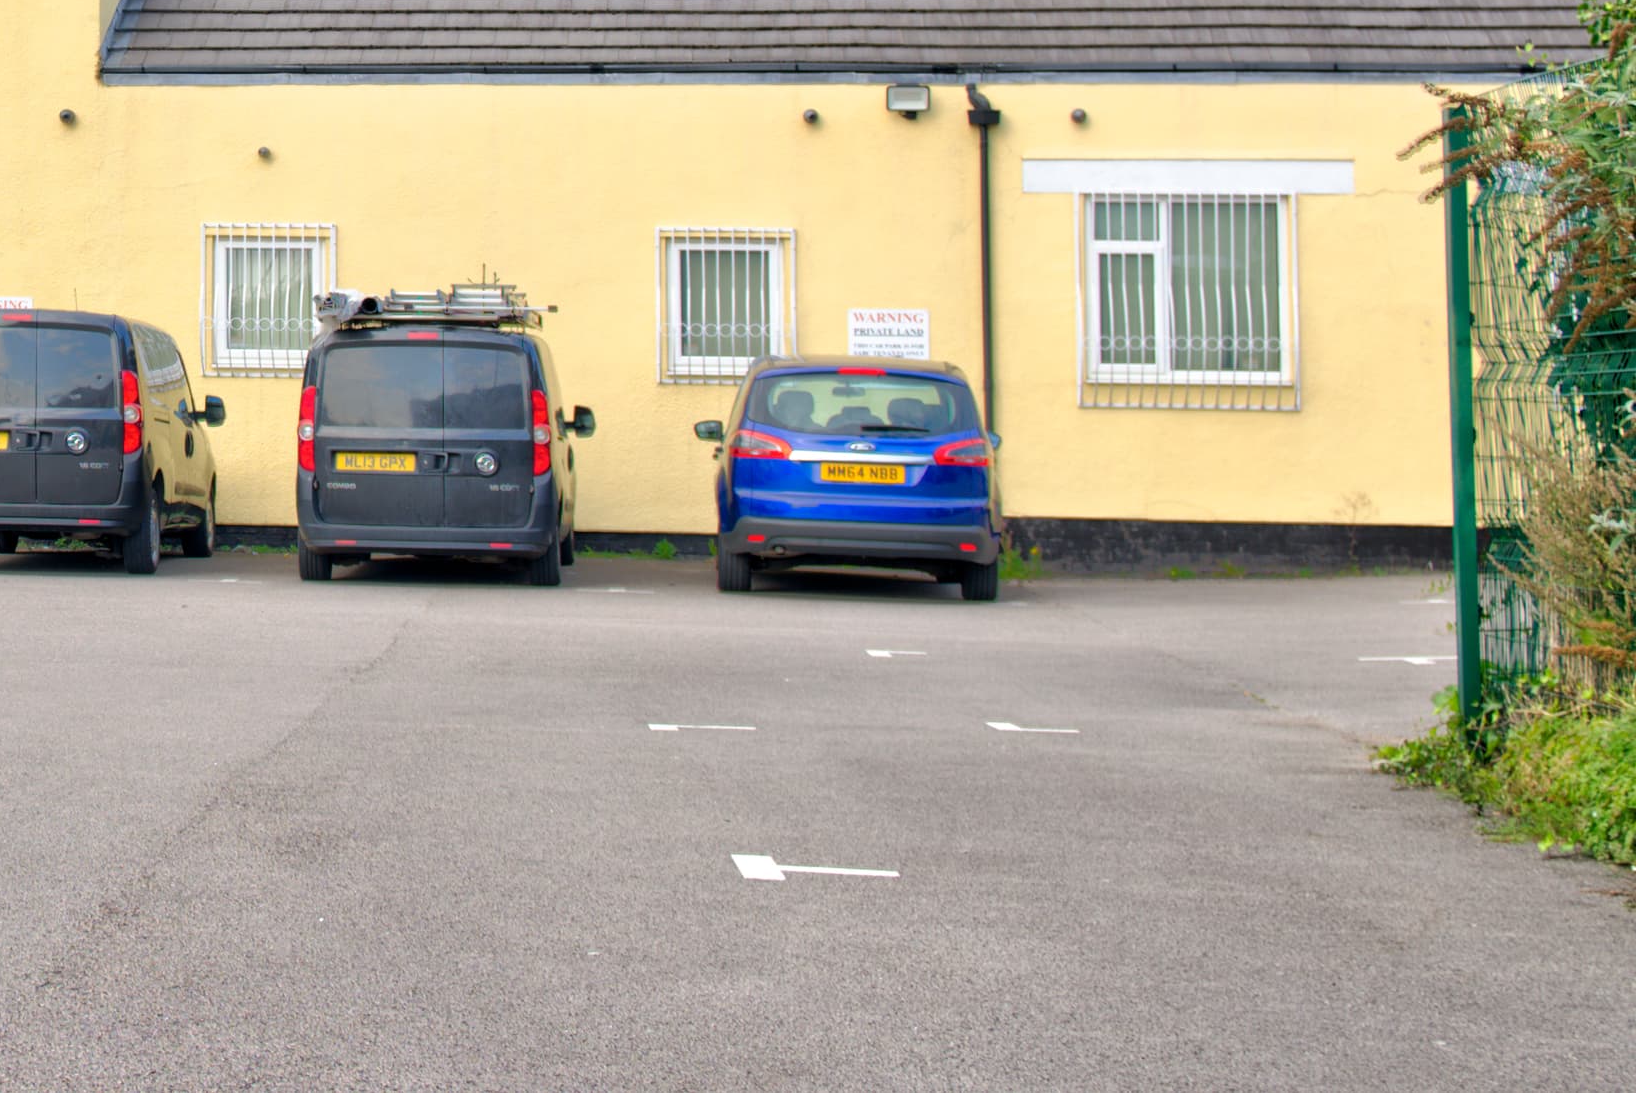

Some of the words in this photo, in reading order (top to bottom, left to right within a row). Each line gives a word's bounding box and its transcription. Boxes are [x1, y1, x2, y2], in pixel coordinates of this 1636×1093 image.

[853, 312, 924, 324] WARNING
[854, 327, 893, 337] PRIVATE
[897, 327, 924, 337] LAND
[379, 455, 406, 470] GPX
[827, 465, 864, 479] MM64
[869, 467, 898, 481] NBB
